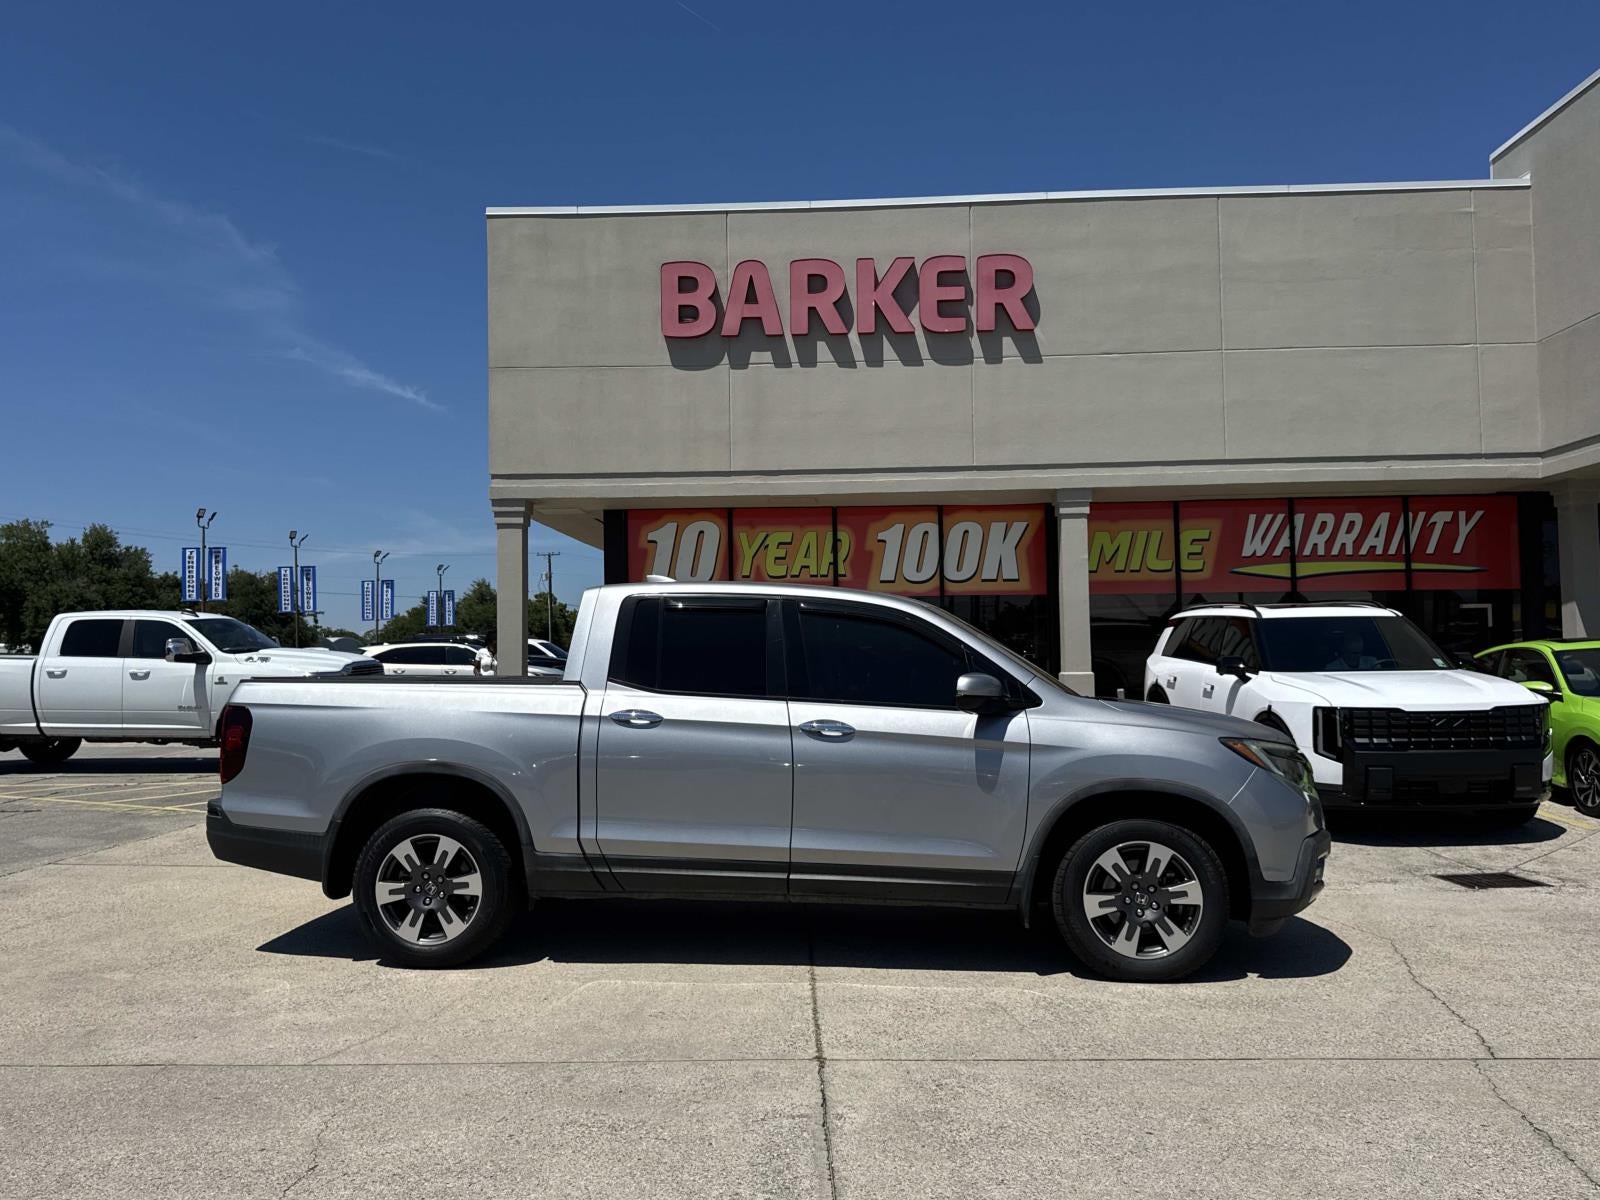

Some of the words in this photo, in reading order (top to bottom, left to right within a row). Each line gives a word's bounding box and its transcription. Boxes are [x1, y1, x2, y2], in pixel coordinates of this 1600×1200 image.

[660, 253, 1035, 338] BARKER
[647, 520, 721, 582] 10
[738, 531, 850, 579] YEAR
[876, 521, 1030, 584] 100K
[1089, 529, 1212, 573] MILE
[1241, 509, 1486, 559] WARRANTY
